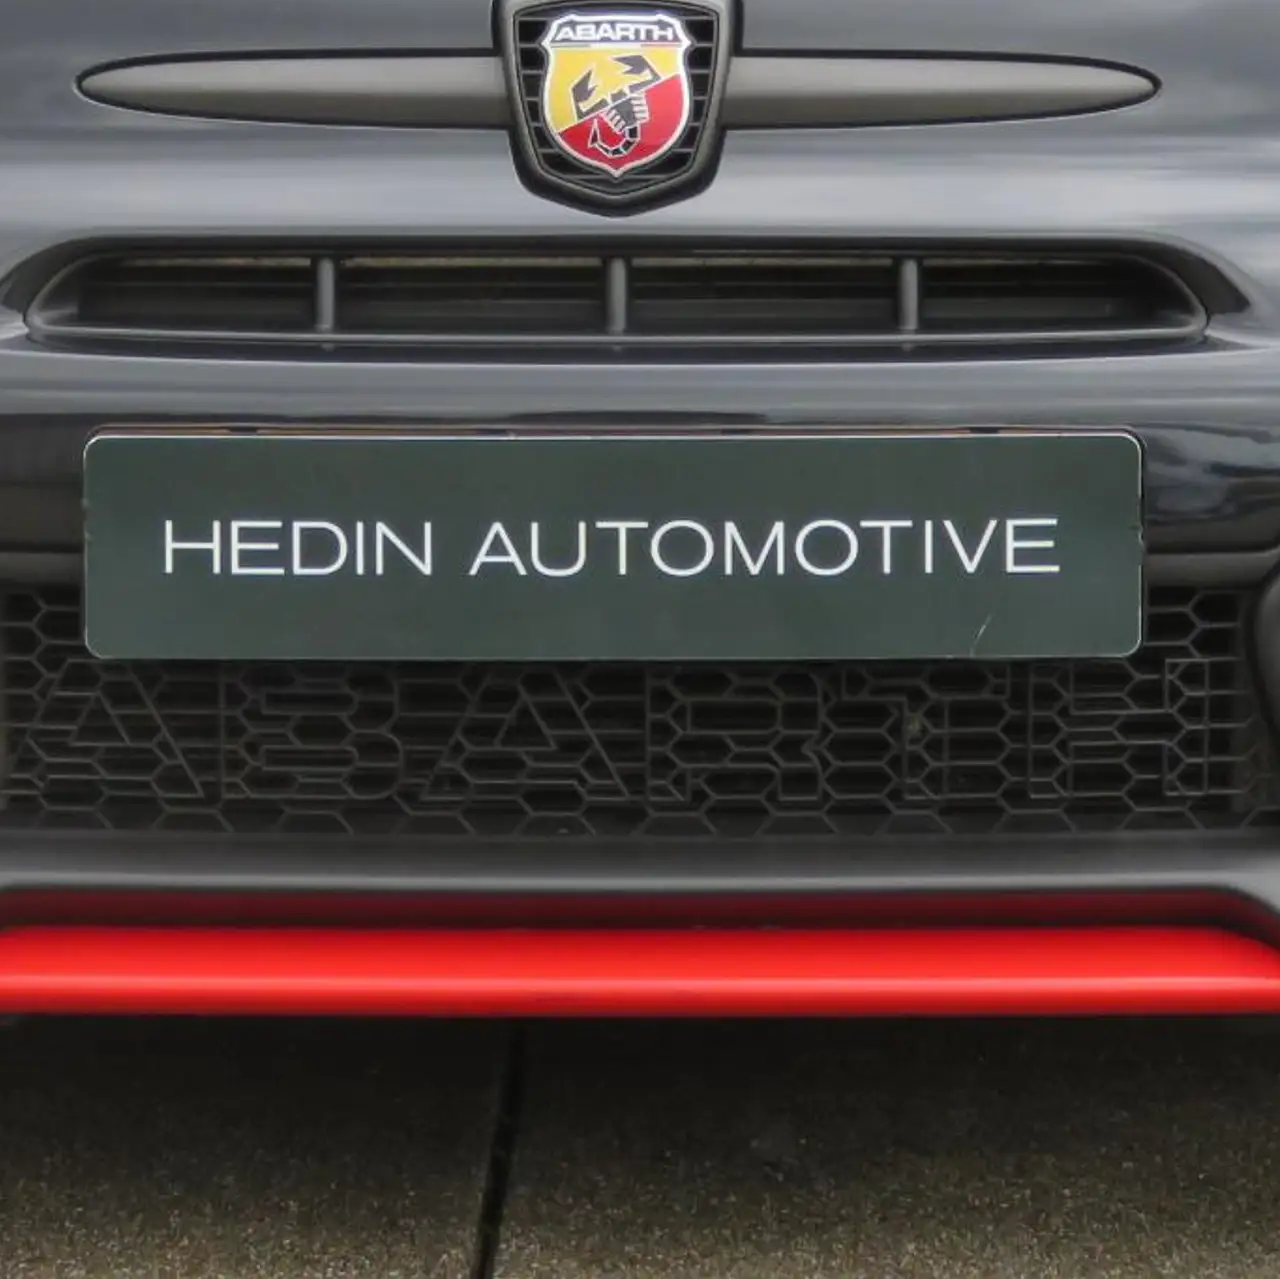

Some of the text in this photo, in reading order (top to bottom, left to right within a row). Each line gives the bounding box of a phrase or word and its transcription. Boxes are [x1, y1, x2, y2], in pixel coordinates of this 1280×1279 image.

[555, 22, 673, 42] ABARTH
[164, 518, 1060, 577] HEDIN AUTOMOTIVE
[6, 656, 1210, 800] ABARTH
